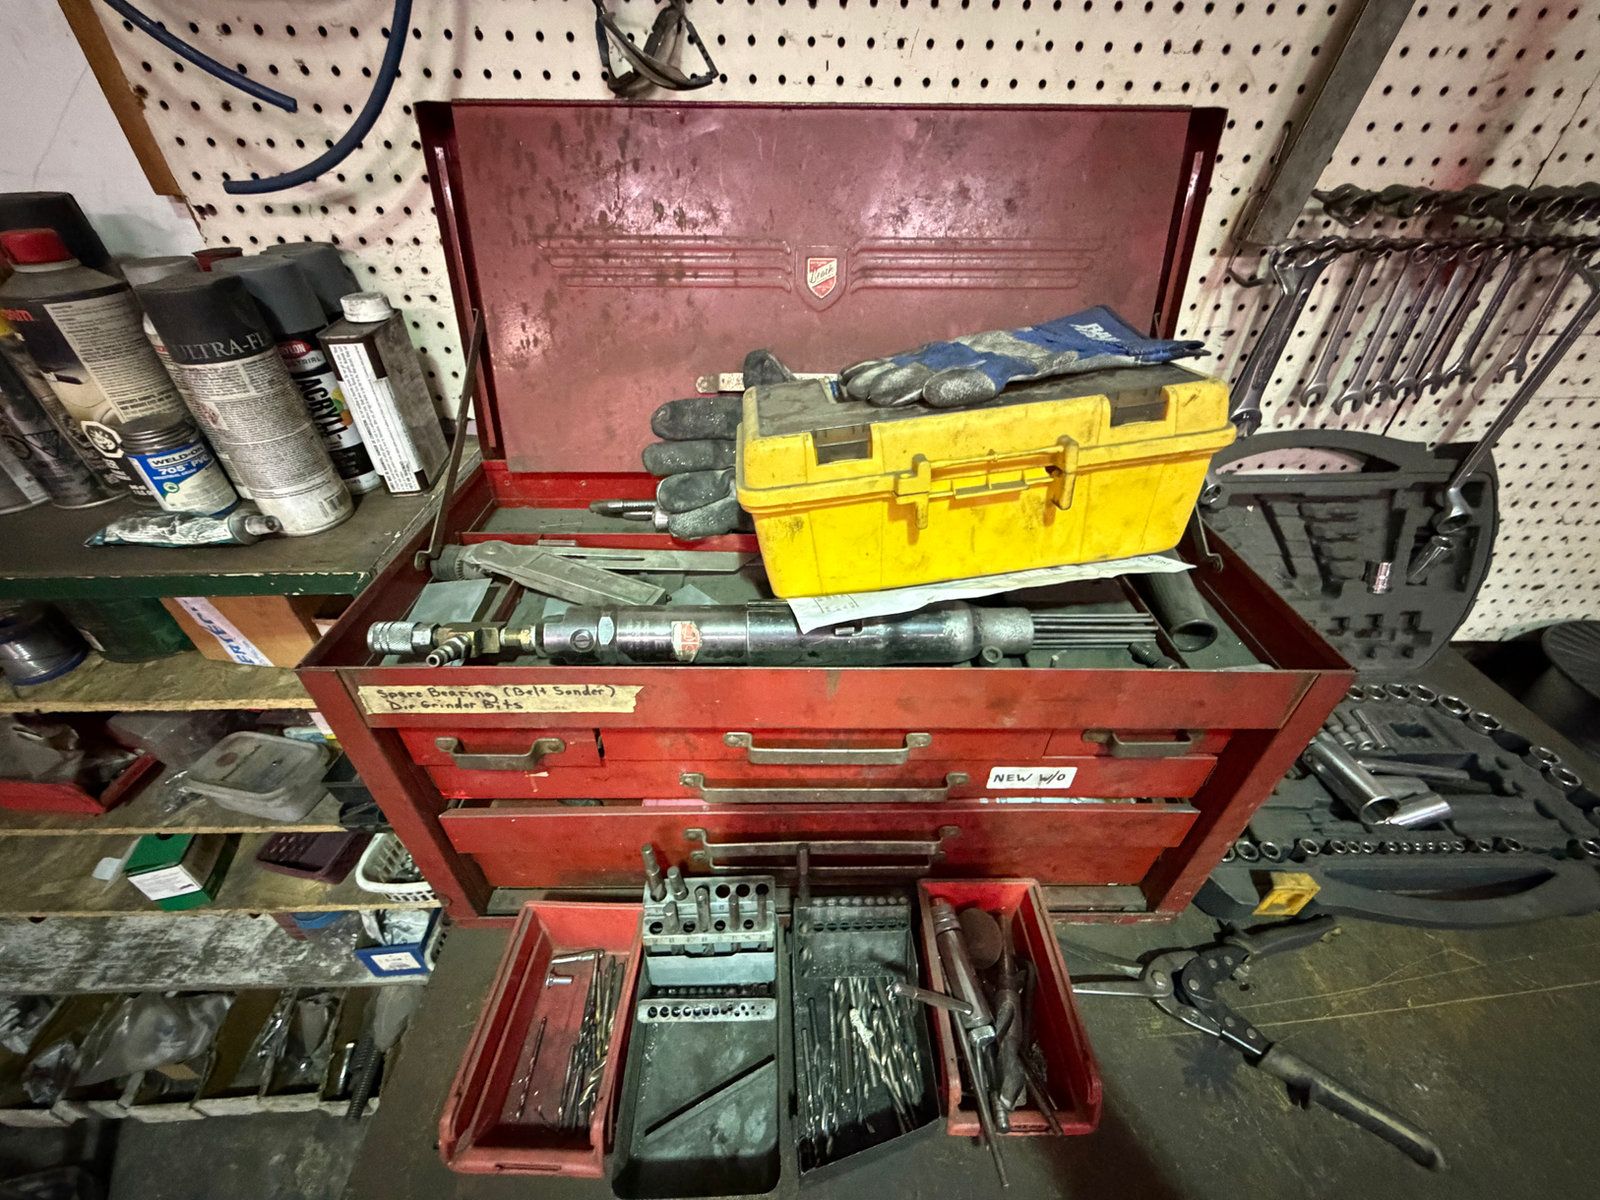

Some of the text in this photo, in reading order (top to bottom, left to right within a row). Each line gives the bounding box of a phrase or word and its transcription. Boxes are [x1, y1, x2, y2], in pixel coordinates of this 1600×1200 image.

[158, 464, 186, 475] 705
[376, 684, 616, 704] Spare Bearing (Belt Sander)
[420, 697, 477, 709] Grinder
[481, 699, 524, 710] Bits
[993, 772, 1034, 783] NEW
